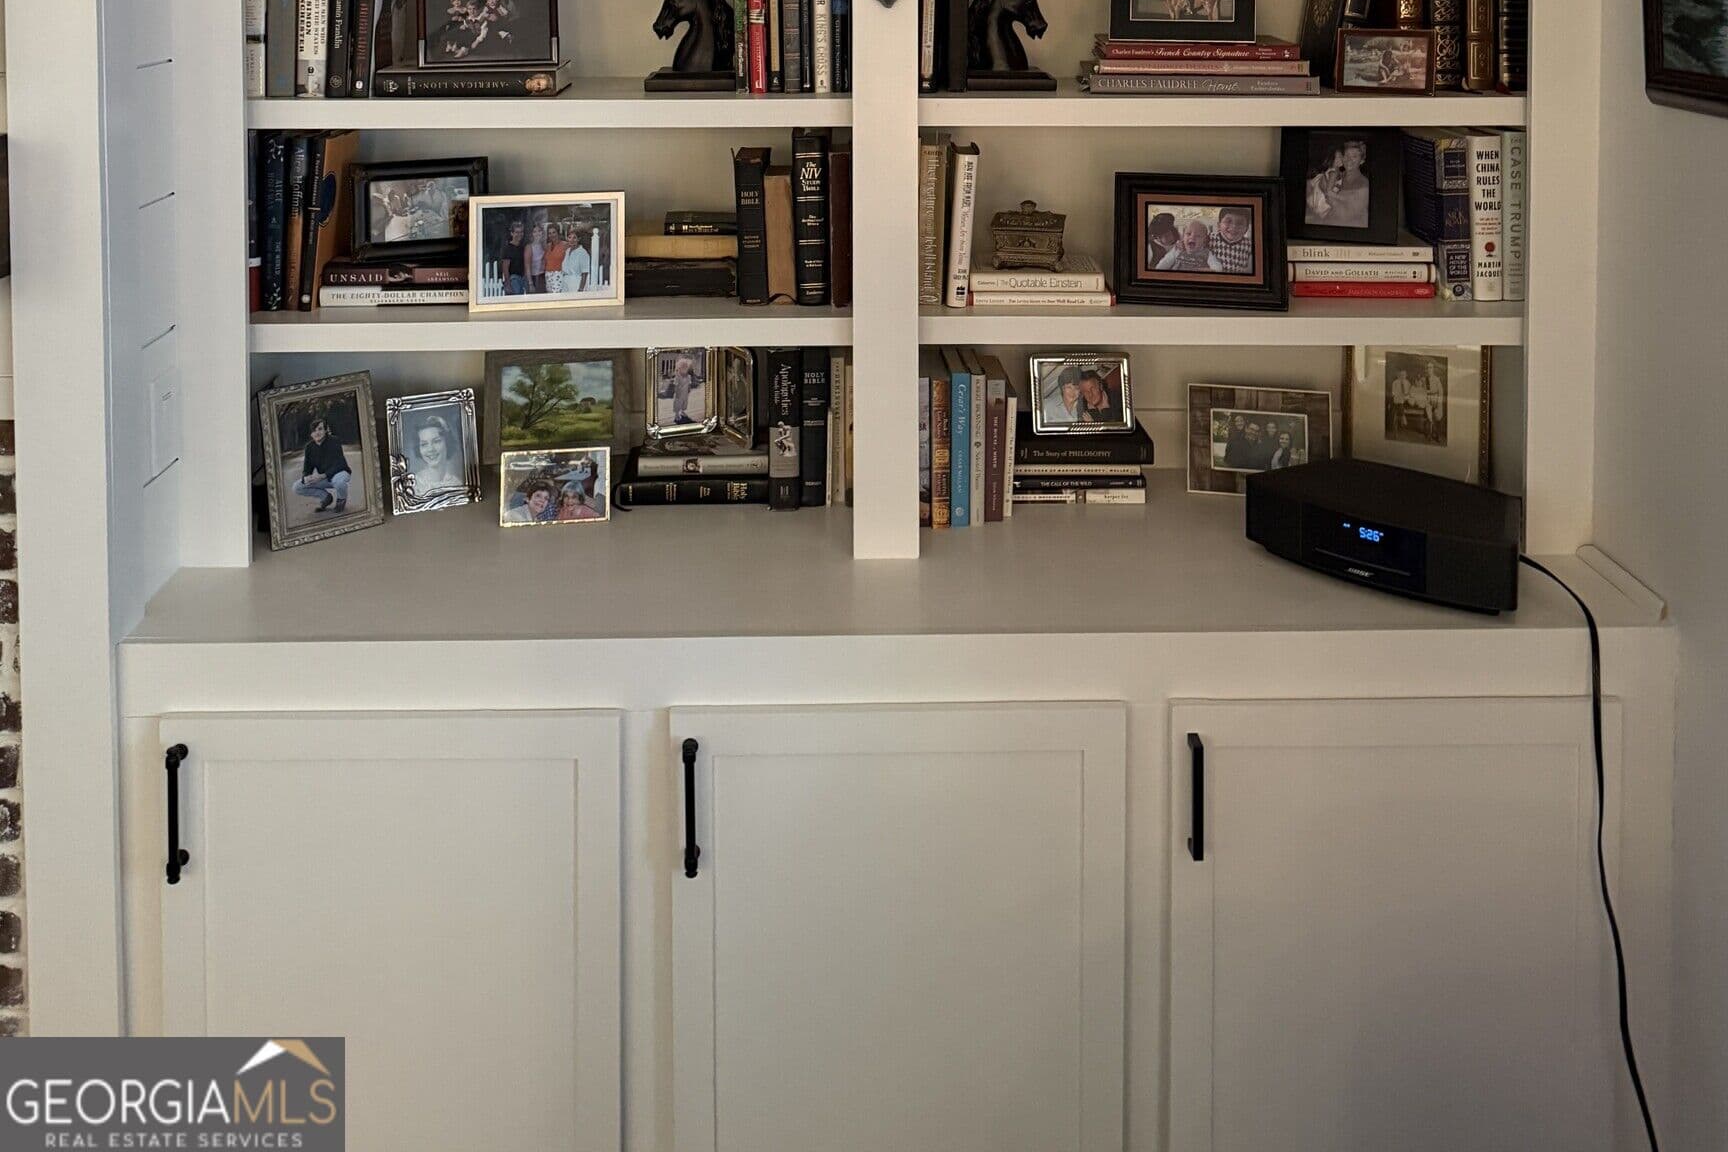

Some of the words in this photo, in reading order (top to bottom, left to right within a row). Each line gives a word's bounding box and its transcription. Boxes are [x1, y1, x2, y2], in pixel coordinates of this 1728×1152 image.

[816, 13, 826, 43] KING'S
[334, 19, 343, 49] Franklin
[1154, 47, 1181, 58] French
[1182, 48, 1211, 58] Country
[1212, 48, 1250, 58] Signature
[816, 46, 826, 77] CROSS
[1098, 78, 1149, 89] CHARLES
[1150, 78, 1199, 89] FAUDREE
[293, 147, 304, 173] Alice
[1476, 150, 1500, 160] WHEN
[1476, 163, 1501, 173] CHINA
[1511, 146, 1521, 189] CASE
[800, 168, 822, 180] NIV
[1476, 176, 1501, 186] RULES
[290, 175, 304, 220] Hoffman
[1482, 189, 1497, 198] THE
[740, 198, 760, 206] BIBLE
[1474, 201, 1502, 211] WORLD
[1511, 201, 1522, 260] TRUMP
[1302, 247, 1331, 258] blink
[1477, 261, 1502, 269] MARTIN
[329, 272, 384, 283] UNSAID
[1305, 269, 1330, 277] DAVID
[1344, 268, 1379, 277] GOLIATH
[1008, 277, 1047, 289] Quotable
[1049, 277, 1083, 289] Einstein
[350, 291, 417, 300] EIGHTY-DOLLAR
[420, 291, 465, 299] CHAMPION
[779, 363, 793, 416] Apologetics
[957, 383, 967, 412] Cesar's
[956, 415, 966, 435] Way
[1046, 450, 1061, 459] Story
